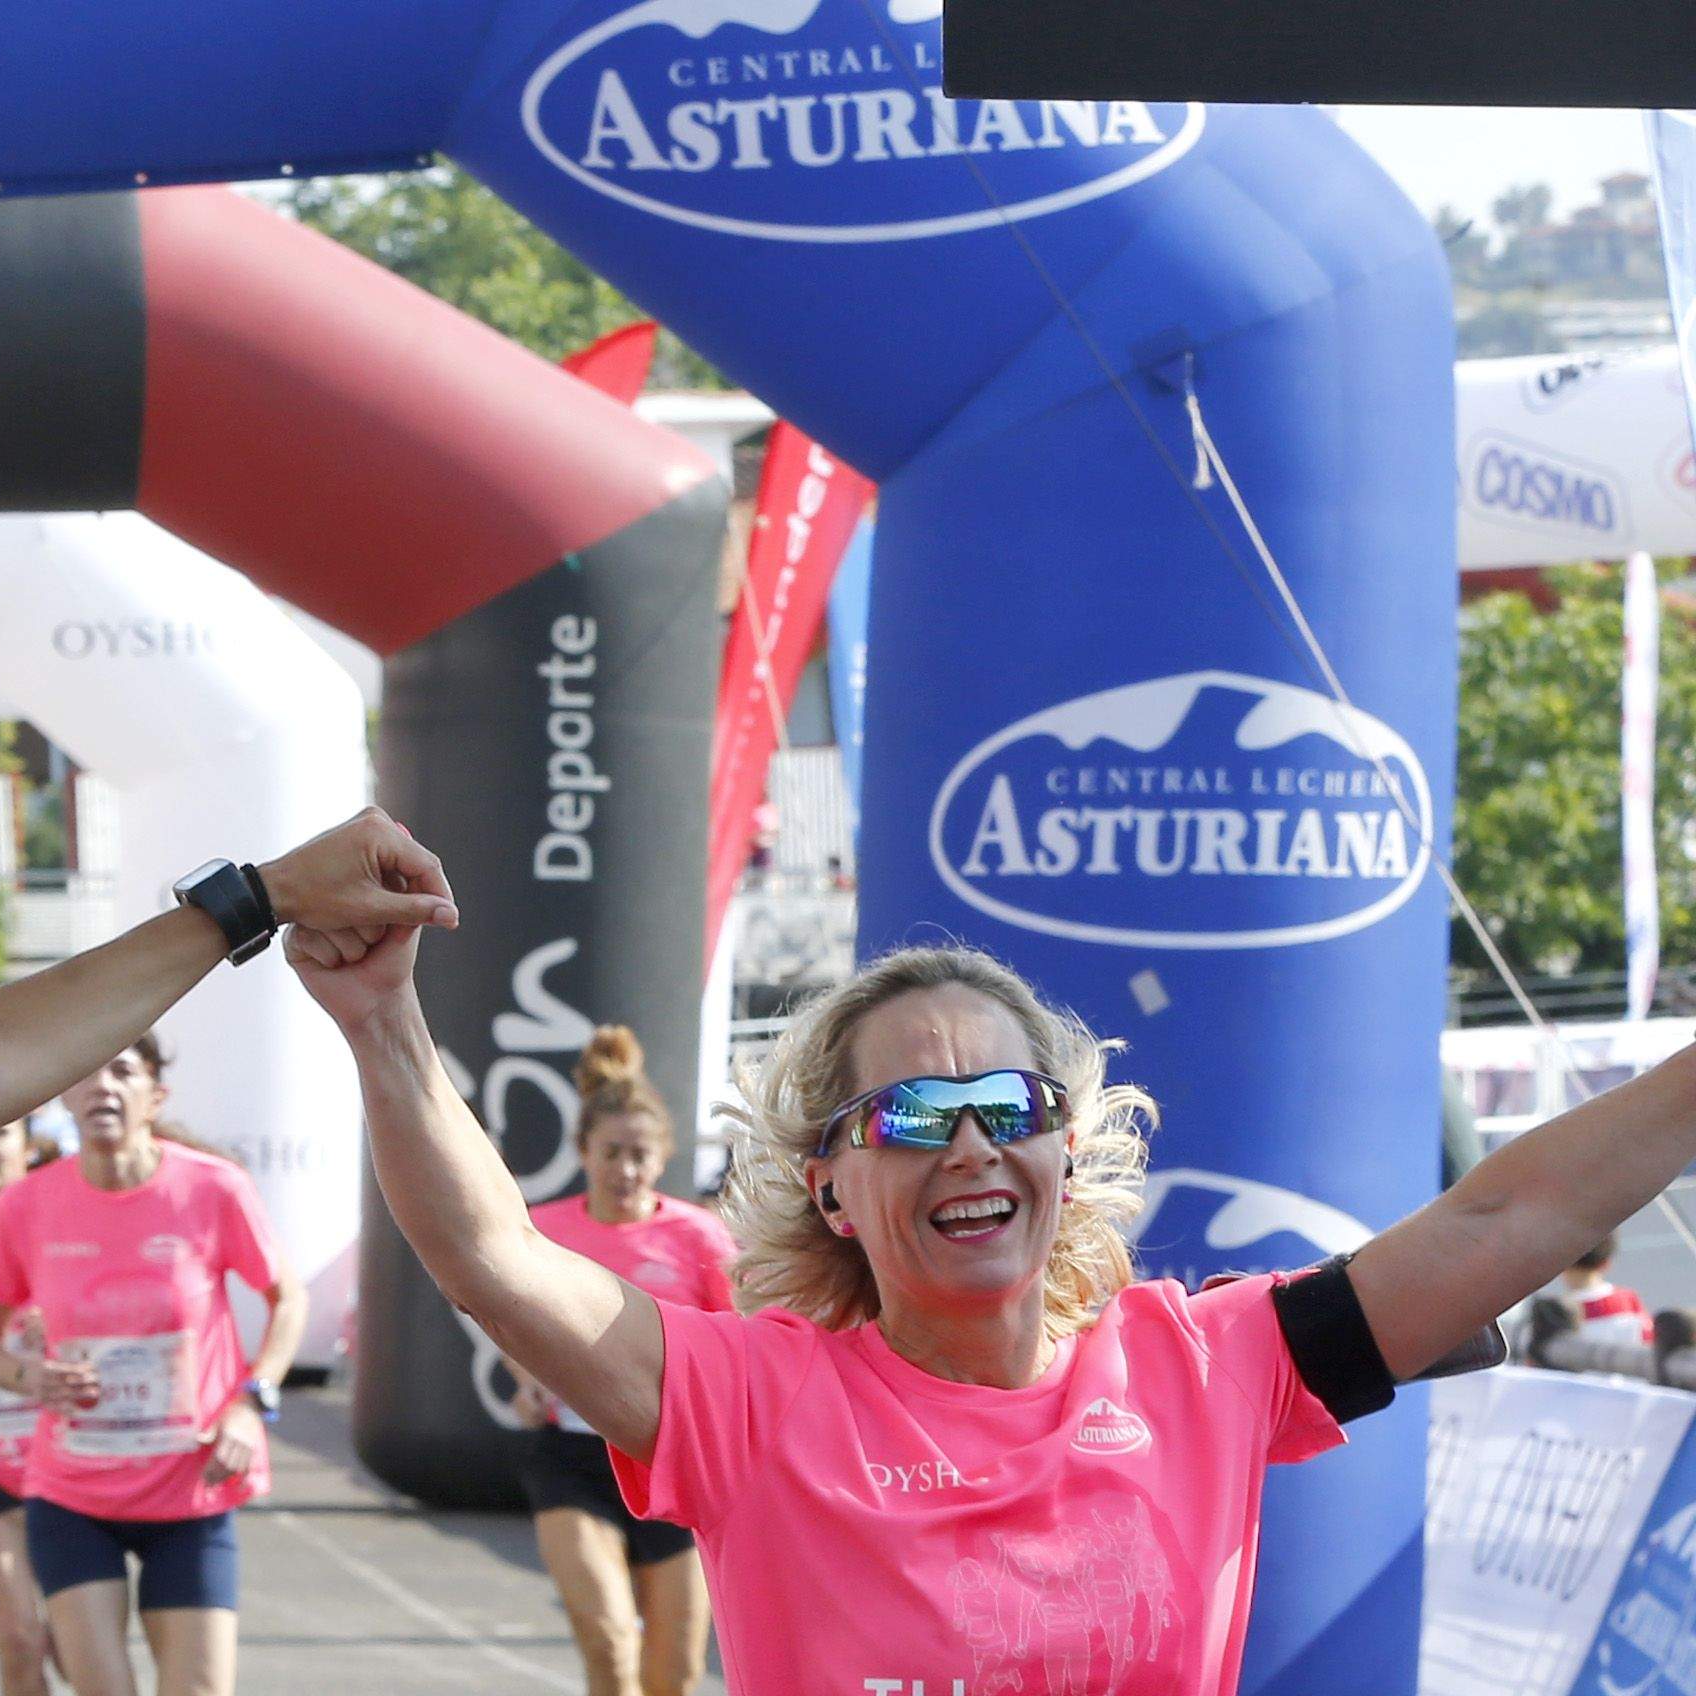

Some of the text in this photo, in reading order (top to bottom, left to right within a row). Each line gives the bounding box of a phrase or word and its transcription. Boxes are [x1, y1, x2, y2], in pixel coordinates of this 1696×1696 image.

[669, 46, 891, 86] CENTRAL
[534, 612, 611, 882] Deporte
[1046, 767, 1232, 795] CENTRAL
[961, 774, 1410, 878] ASTURIANA
